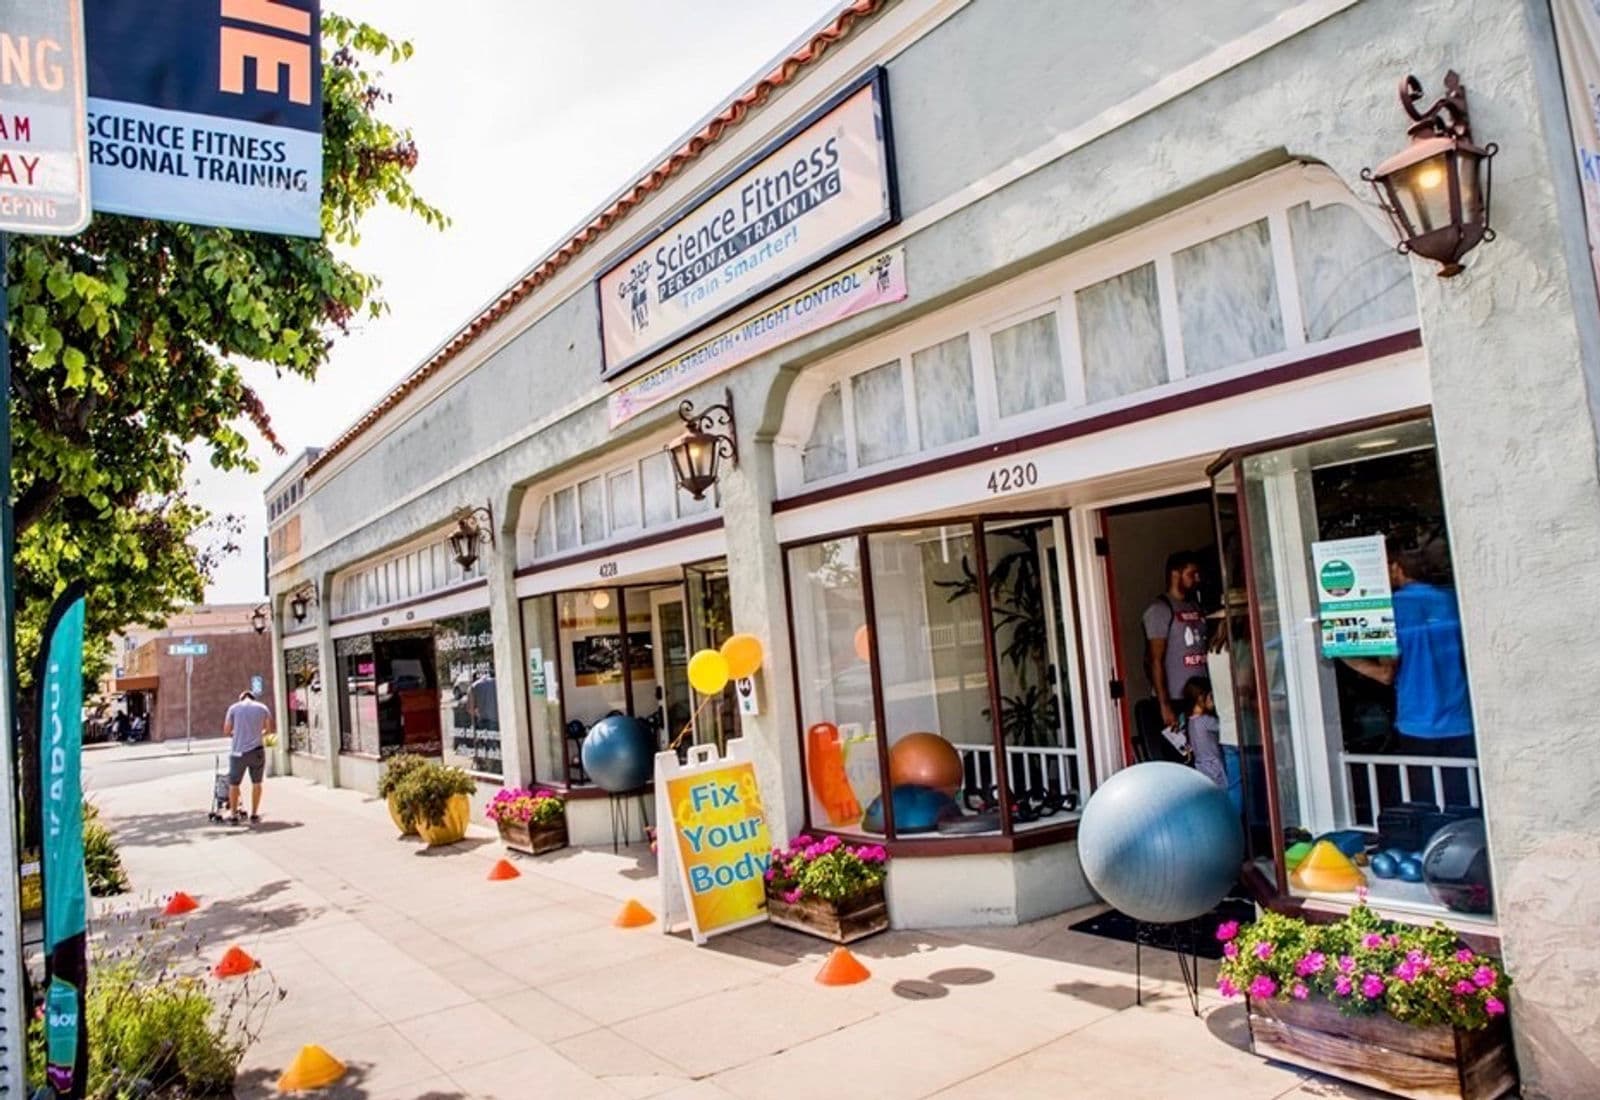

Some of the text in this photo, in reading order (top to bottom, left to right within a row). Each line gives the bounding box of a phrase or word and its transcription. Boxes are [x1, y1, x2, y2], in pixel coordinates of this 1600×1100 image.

[192, 129, 287, 163] FITNESS
[194, 155, 308, 192] TRAINING
[655, 137, 839, 281] Science Fitness
[659, 173, 839, 300] PERSONAL TRAINING
[682, 226, 799, 307] Train Smarter!
[638, 272, 861, 392] HEALTH STRENGTH WEIGHT CONTROL
[987, 462, 1038, 494] 4230
[691, 781, 740, 813] Fix
[683, 818, 761, 853] Your
[690, 851, 773, 894] Body
